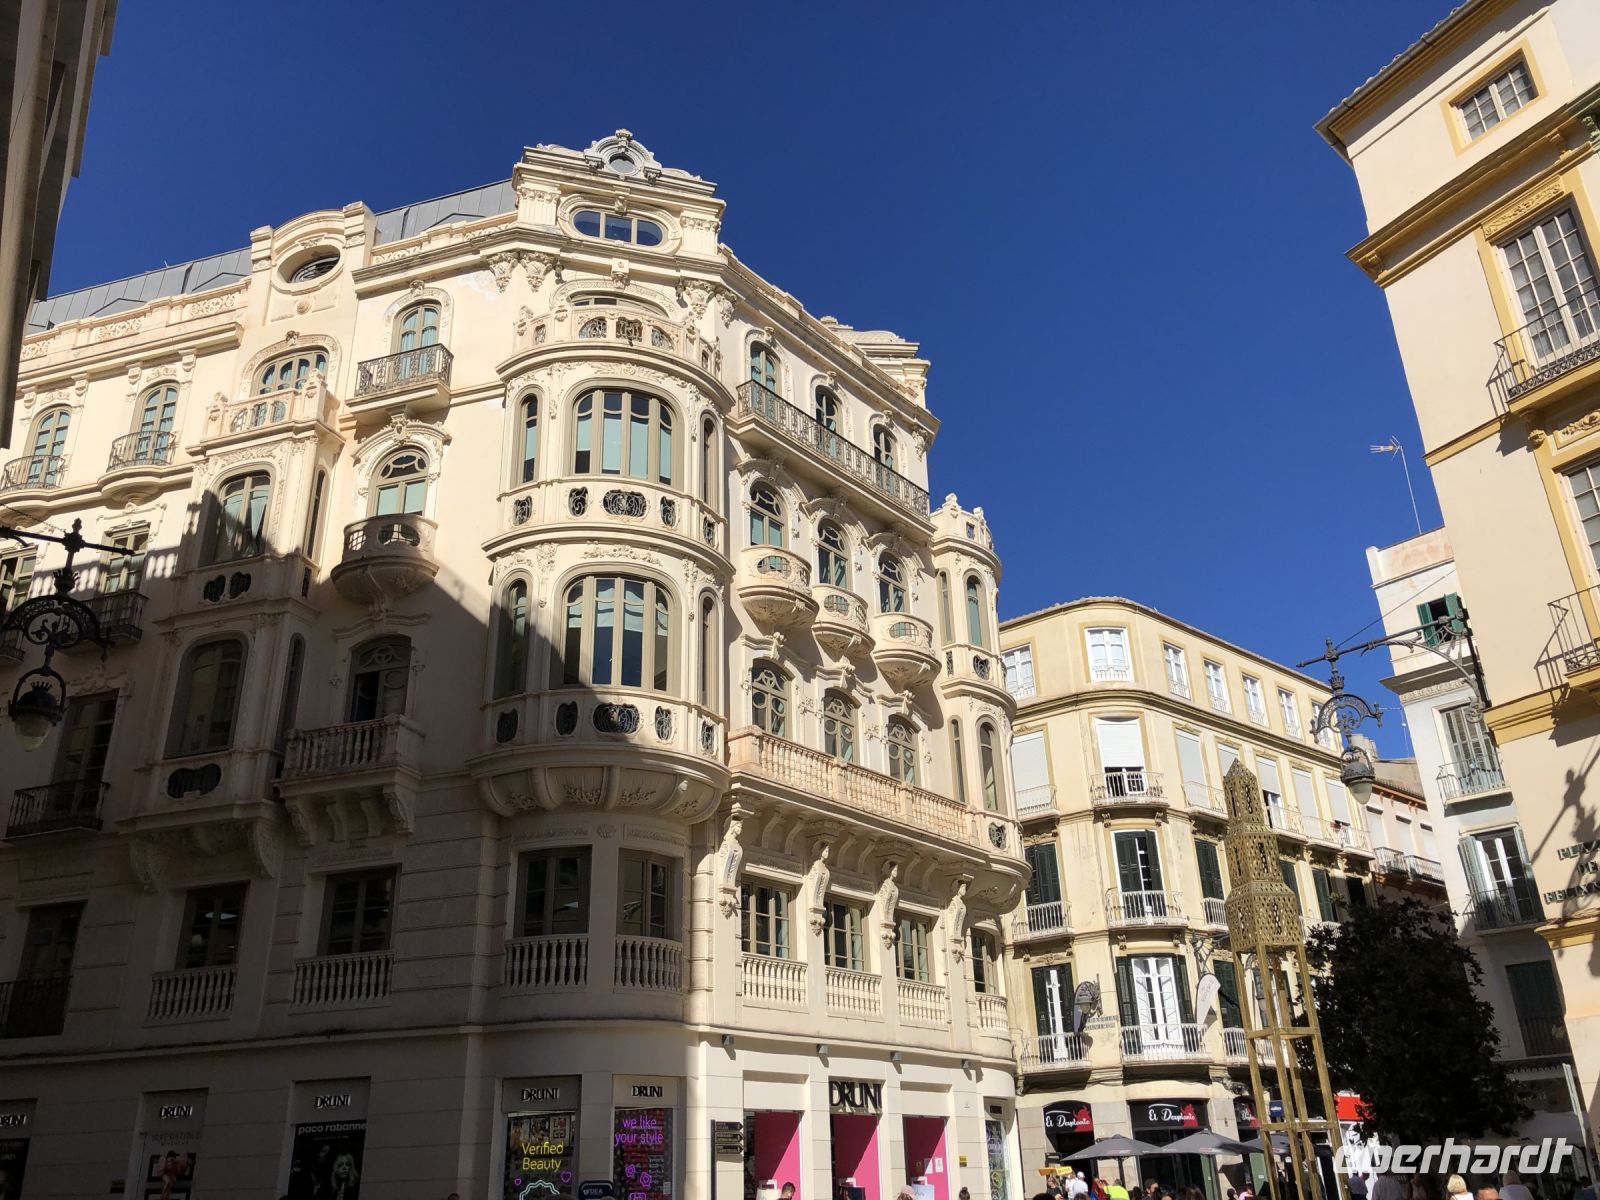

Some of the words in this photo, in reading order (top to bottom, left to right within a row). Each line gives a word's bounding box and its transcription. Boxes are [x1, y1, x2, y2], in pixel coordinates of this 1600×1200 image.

[521, 1088, 559, 1102] DRUNI
[632, 1085, 663, 1098] DRUNI
[829, 1081, 882, 1108] DRUNI
[314, 1094, 351, 1109] DRUNI
[159, 1104, 193, 1119] DRUNI
[1148, 1108, 1158, 1121] El
[622, 1117, 637, 1128] we
[639, 1114, 657, 1128] like
[1045, 1115, 1054, 1127] El
[298, 1124, 324, 1136] paco
[326, 1123, 367, 1133] rabanne
[615, 1132, 637, 1146] your
[640, 1132, 664, 1144] style
[522, 1141, 564, 1155] Verified
[522, 1157, 562, 1172] Beauty
